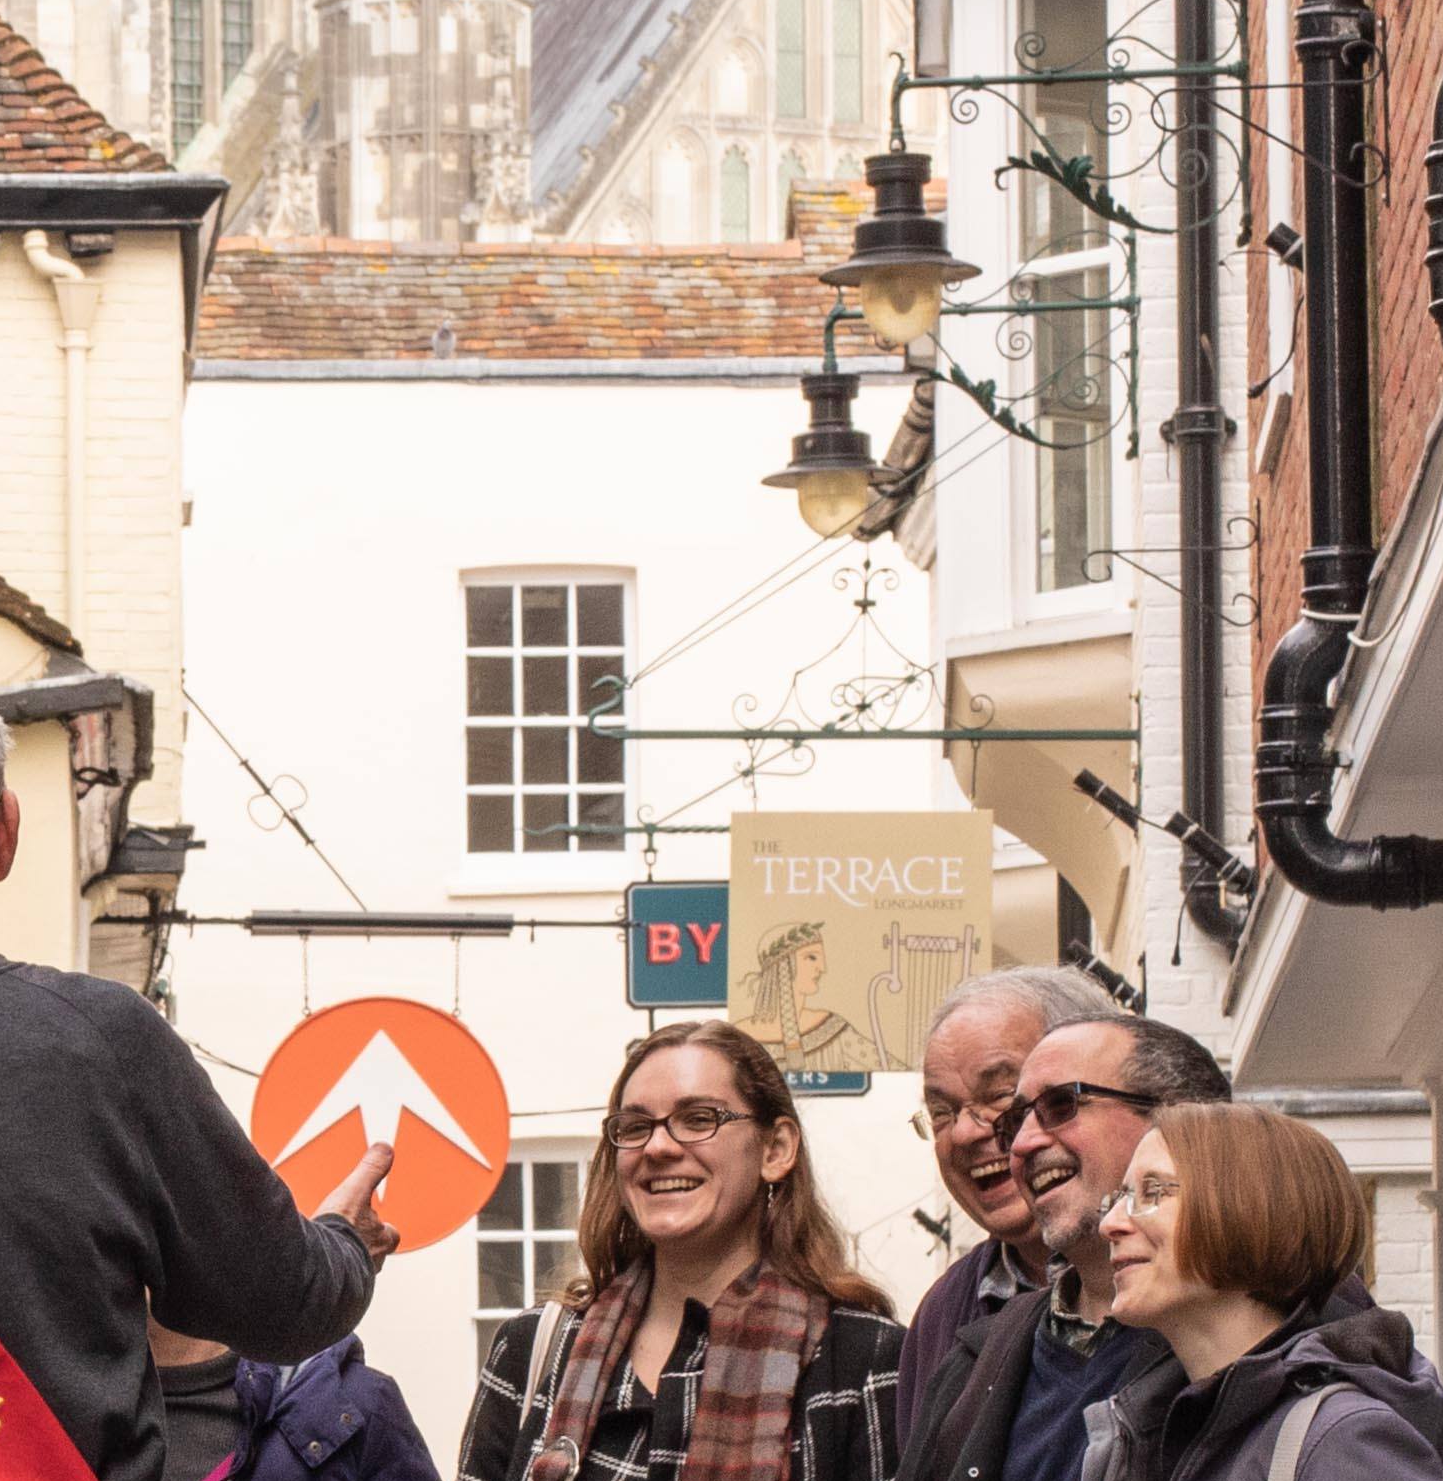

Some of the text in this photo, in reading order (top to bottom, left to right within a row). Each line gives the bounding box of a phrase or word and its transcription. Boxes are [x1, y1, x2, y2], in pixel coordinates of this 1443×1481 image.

[753, 840, 780, 854] THE
[752, 855, 964, 907] TERRACE
[874, 898, 965, 911] LONGMARKET
